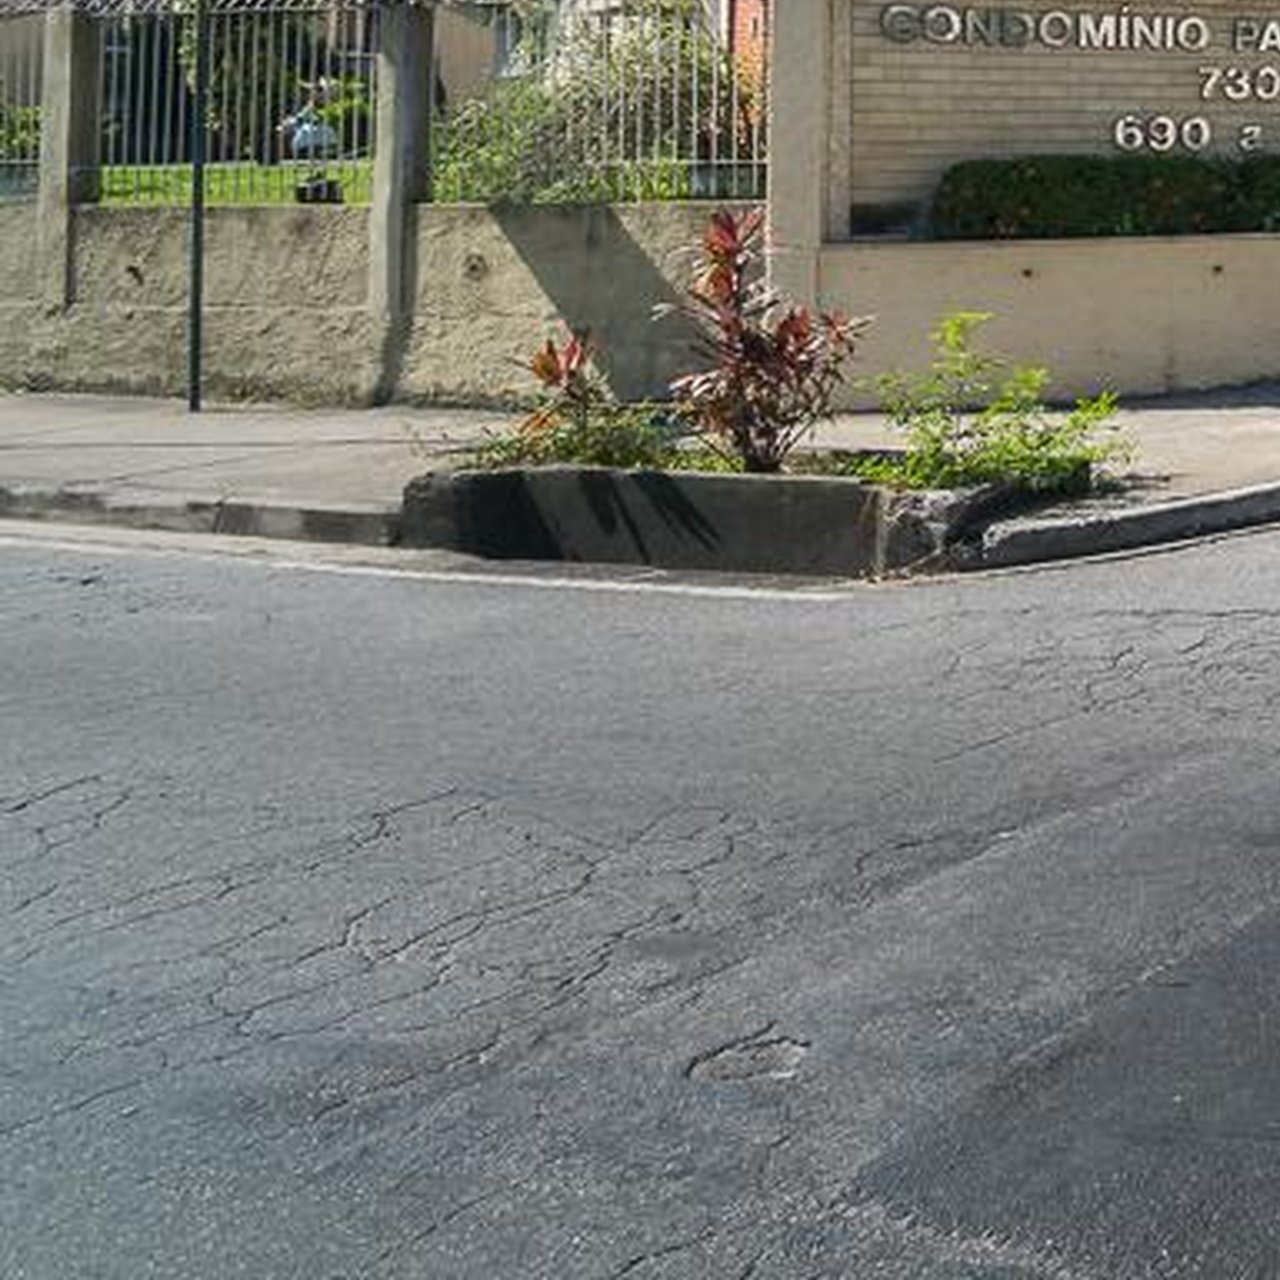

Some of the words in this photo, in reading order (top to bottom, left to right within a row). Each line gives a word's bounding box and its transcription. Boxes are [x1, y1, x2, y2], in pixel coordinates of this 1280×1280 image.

[881, 5, 1209, 51] CONDOMÍNIO
[1199, 65, 1280, 100] 730
[1115, 116, 1211, 151] 690
[1240, 125, 1262, 151] a
